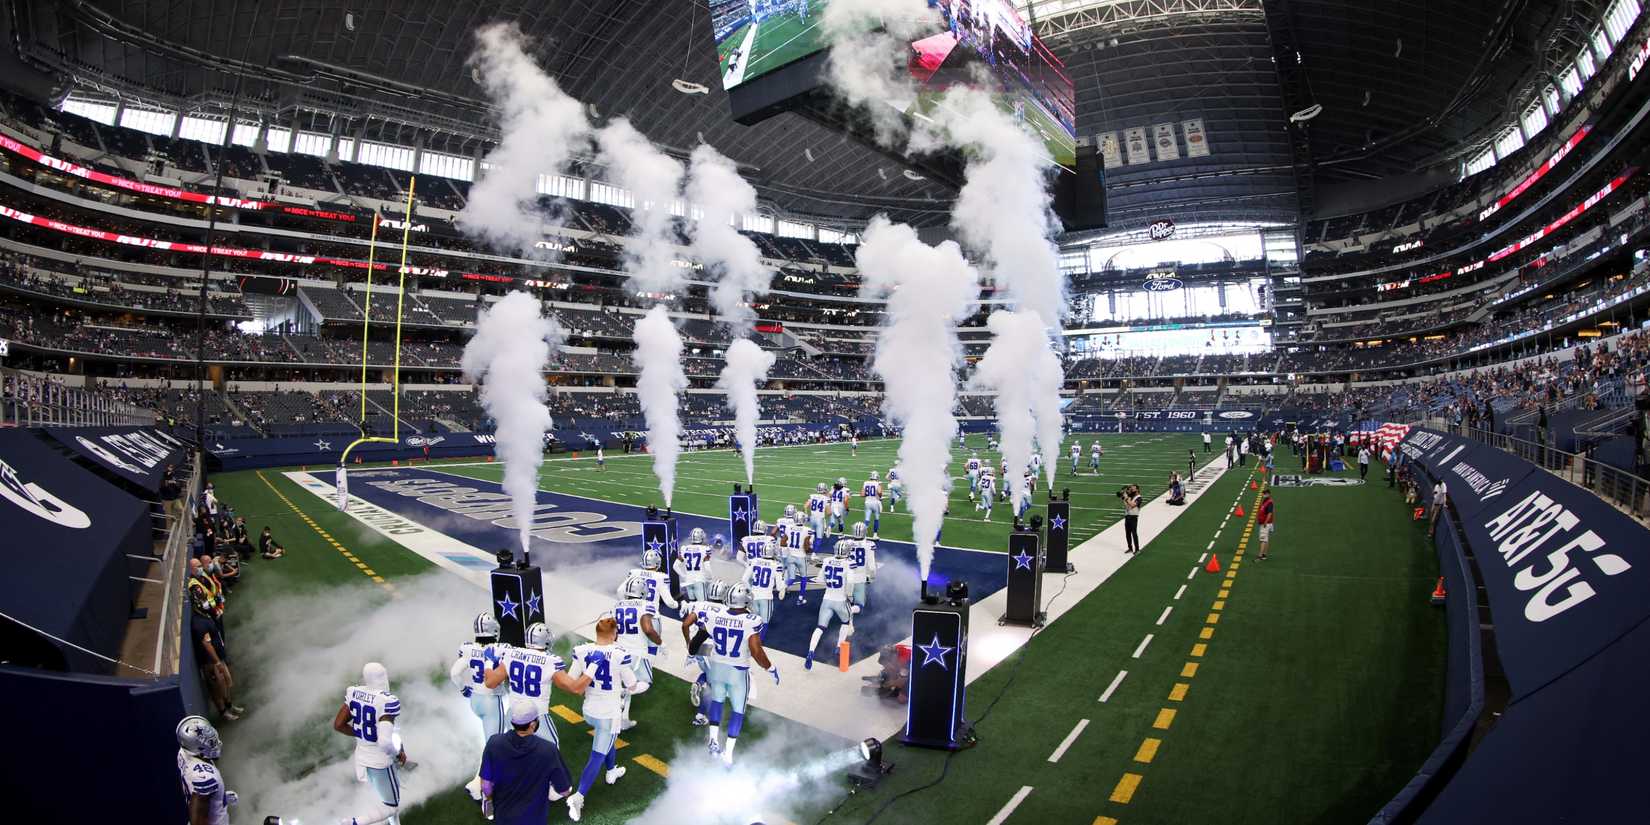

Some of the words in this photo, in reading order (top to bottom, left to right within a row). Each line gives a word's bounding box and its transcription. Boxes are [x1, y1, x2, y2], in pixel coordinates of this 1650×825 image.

[1150, 280, 1176, 291] Ford
[1168, 411, 1196, 419] 1960
[811, 498, 825, 512] 84
[789, 531, 801, 549] 11
[1485, 490, 1580, 567] AT&T
[684, 552, 701, 571] 37
[752, 565, 772, 588] 30
[824, 565, 844, 588] 25
[1514, 529, 1606, 622] 5G
[615, 607, 638, 634] 92
[712, 626, 744, 658] 97
[511, 650, 547, 666] CRAWFORD
[509, 660, 542, 697] 98
[352, 690, 377, 704] WORLEY
[349, 700, 378, 743] 28
